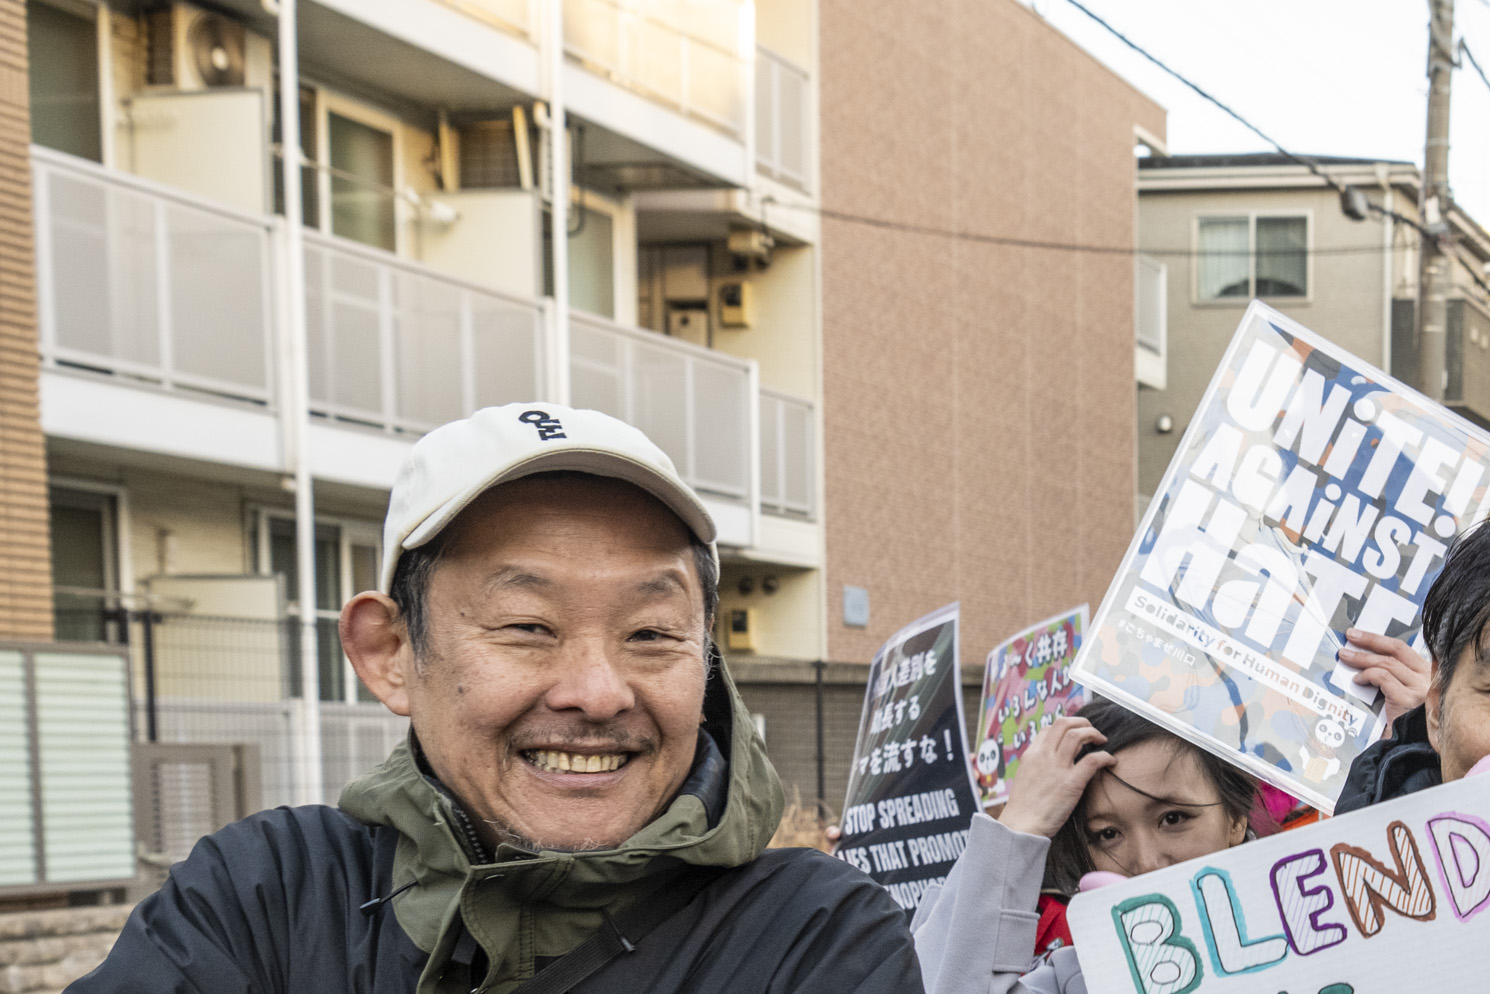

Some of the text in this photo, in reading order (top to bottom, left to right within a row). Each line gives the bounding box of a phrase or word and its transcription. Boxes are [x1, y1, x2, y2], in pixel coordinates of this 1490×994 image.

[1134, 595, 1358, 726] Solidarity for Human Dignity
[845, 788, 960, 835] STOP SPREADING
[869, 841, 909, 872] THAT
[907, 830, 969, 867] PROMOT
